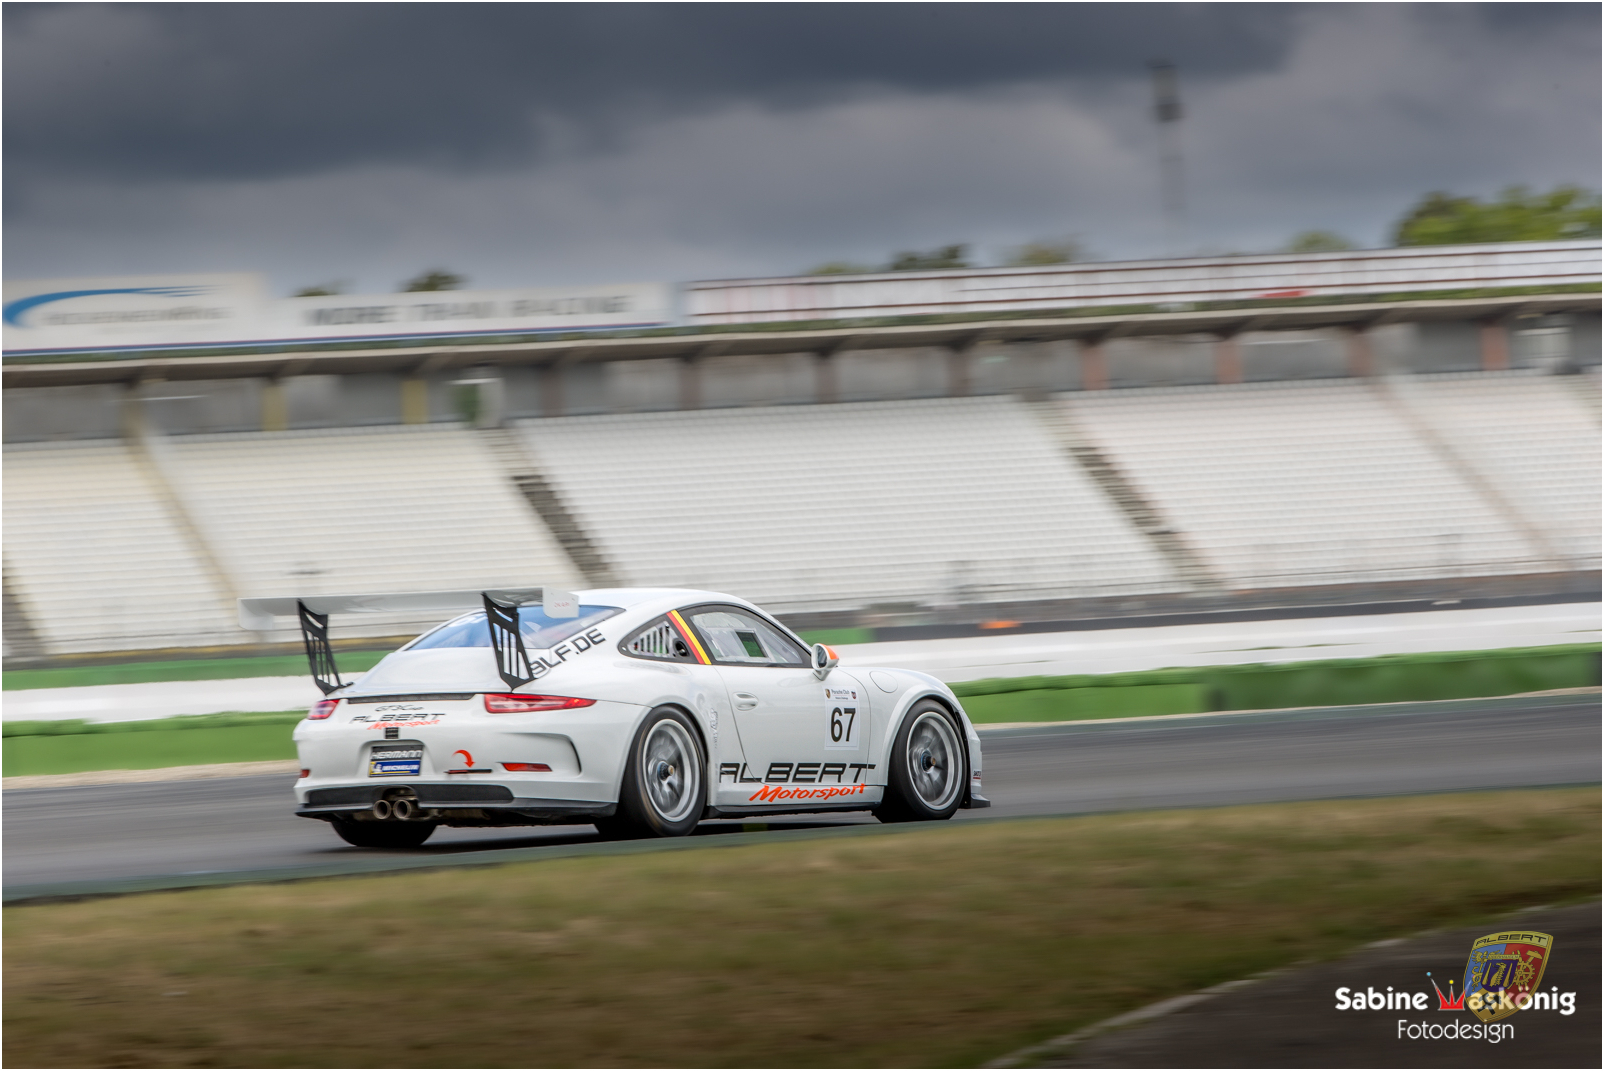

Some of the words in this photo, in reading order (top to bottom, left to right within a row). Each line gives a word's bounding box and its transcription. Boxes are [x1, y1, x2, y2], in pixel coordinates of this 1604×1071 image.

[349, 713, 446, 724] ALBERT
[366, 719, 440, 731] Motorsport
[830, 706, 857, 743] 67
[719, 762, 876, 783] ALBERT
[748, 783, 867, 802] Motorsport
